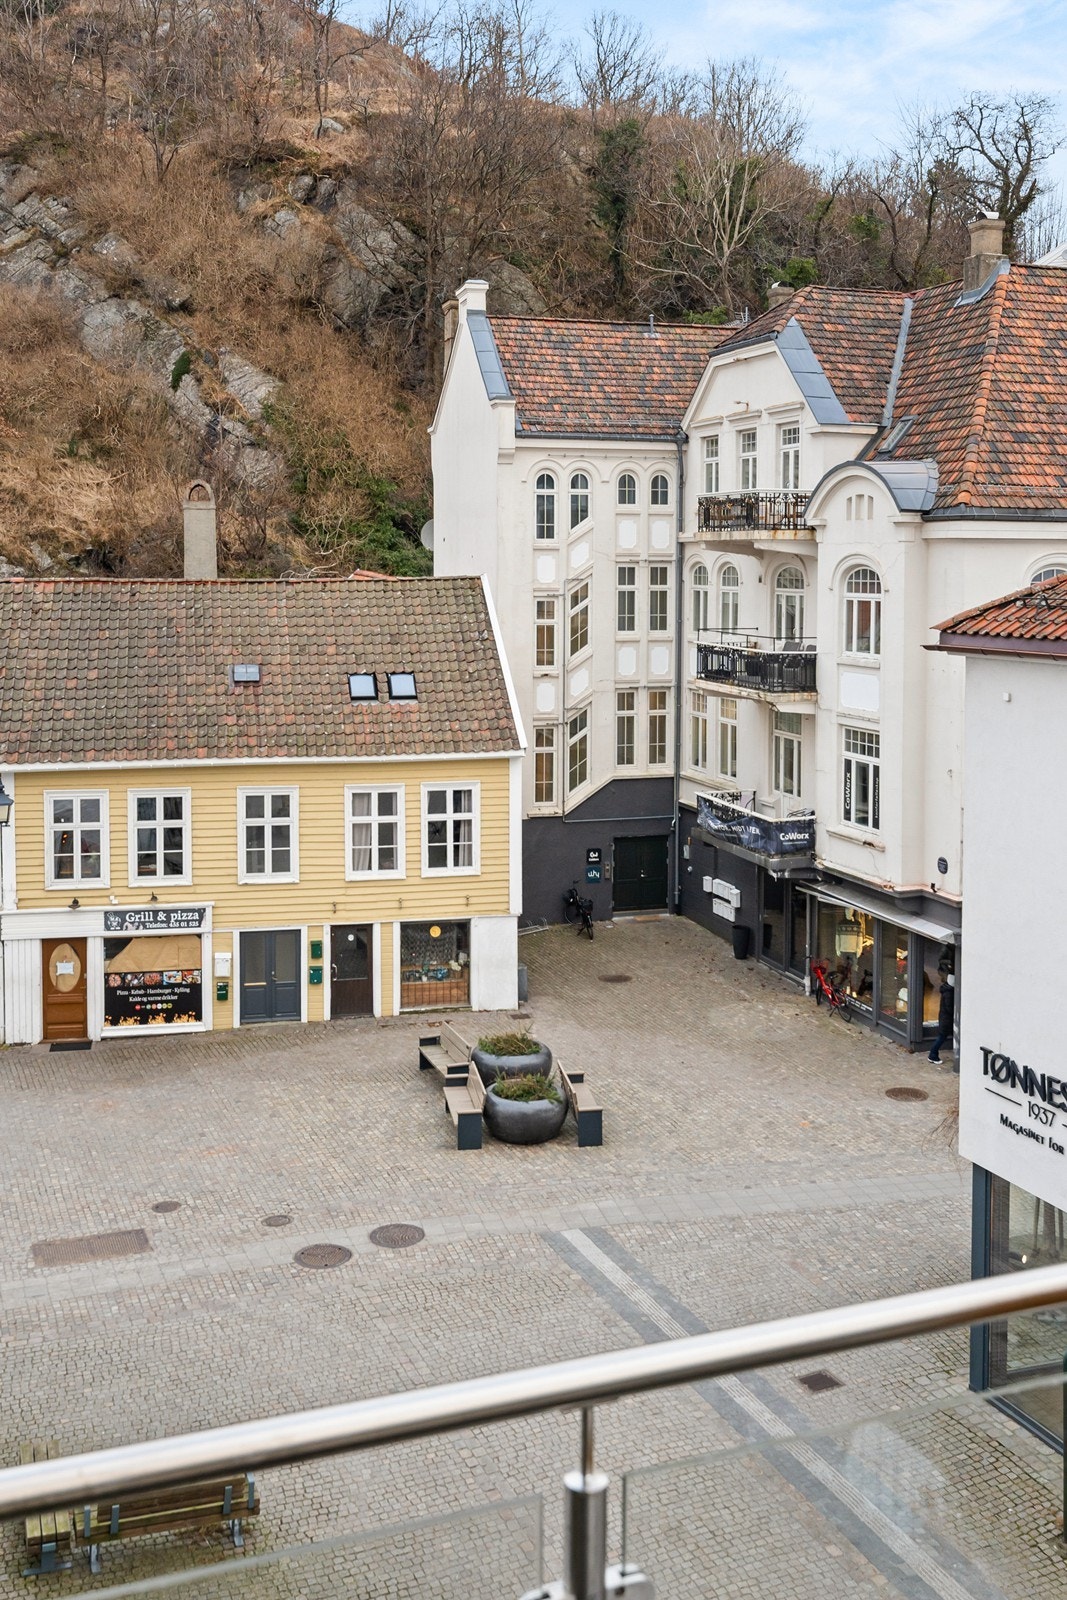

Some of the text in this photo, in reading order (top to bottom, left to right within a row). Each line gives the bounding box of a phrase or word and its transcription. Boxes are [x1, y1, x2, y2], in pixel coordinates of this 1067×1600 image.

[779, 832, 810, 841] CoWorx
[125, 911, 200, 924] Grill & pizza
[1027, 1100, 1056, 1127] 1937
